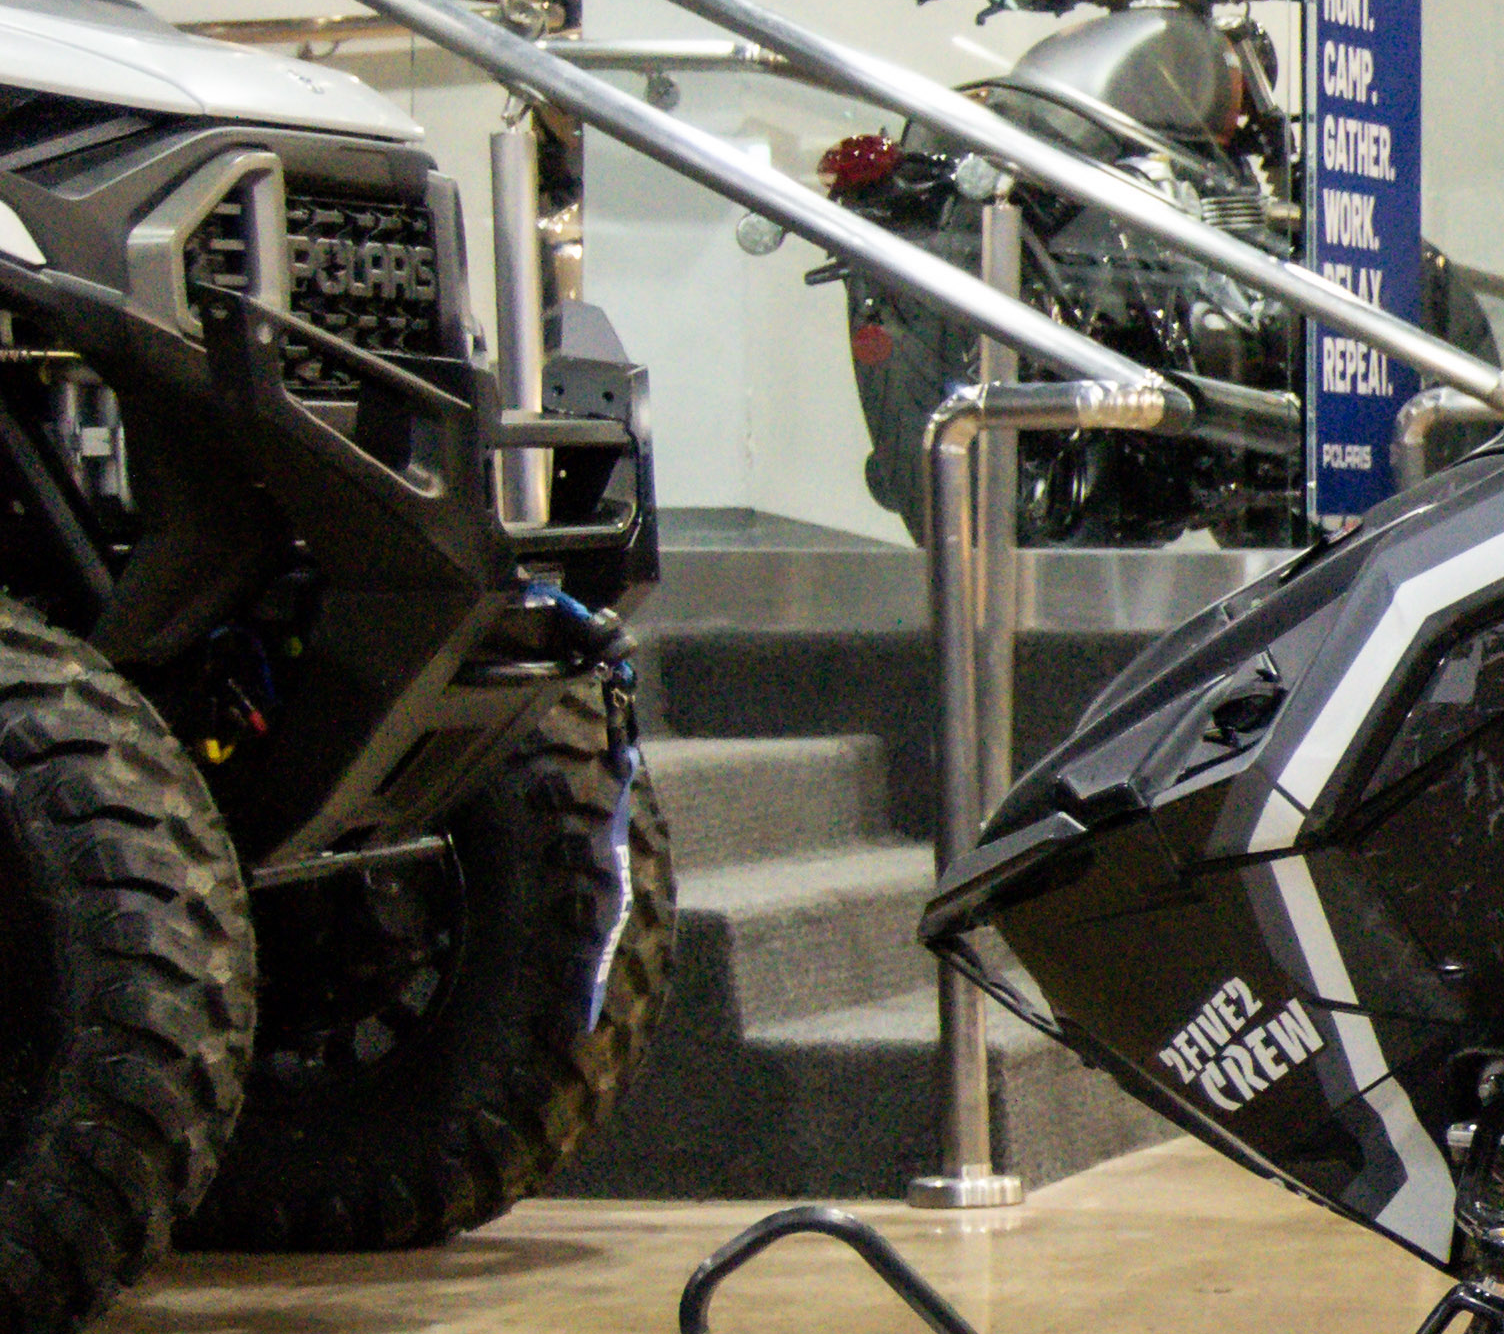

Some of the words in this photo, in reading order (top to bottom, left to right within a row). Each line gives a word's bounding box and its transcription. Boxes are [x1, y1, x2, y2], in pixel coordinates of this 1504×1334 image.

[1323, 40, 1379, 106] CAMP.
[1323, 114, 1396, 182] GATHER.
[1323, 187, 1380, 251] WORK.
[1322, 443, 1373, 470] POLARIS
[1200, 997, 1325, 1112] CREW
